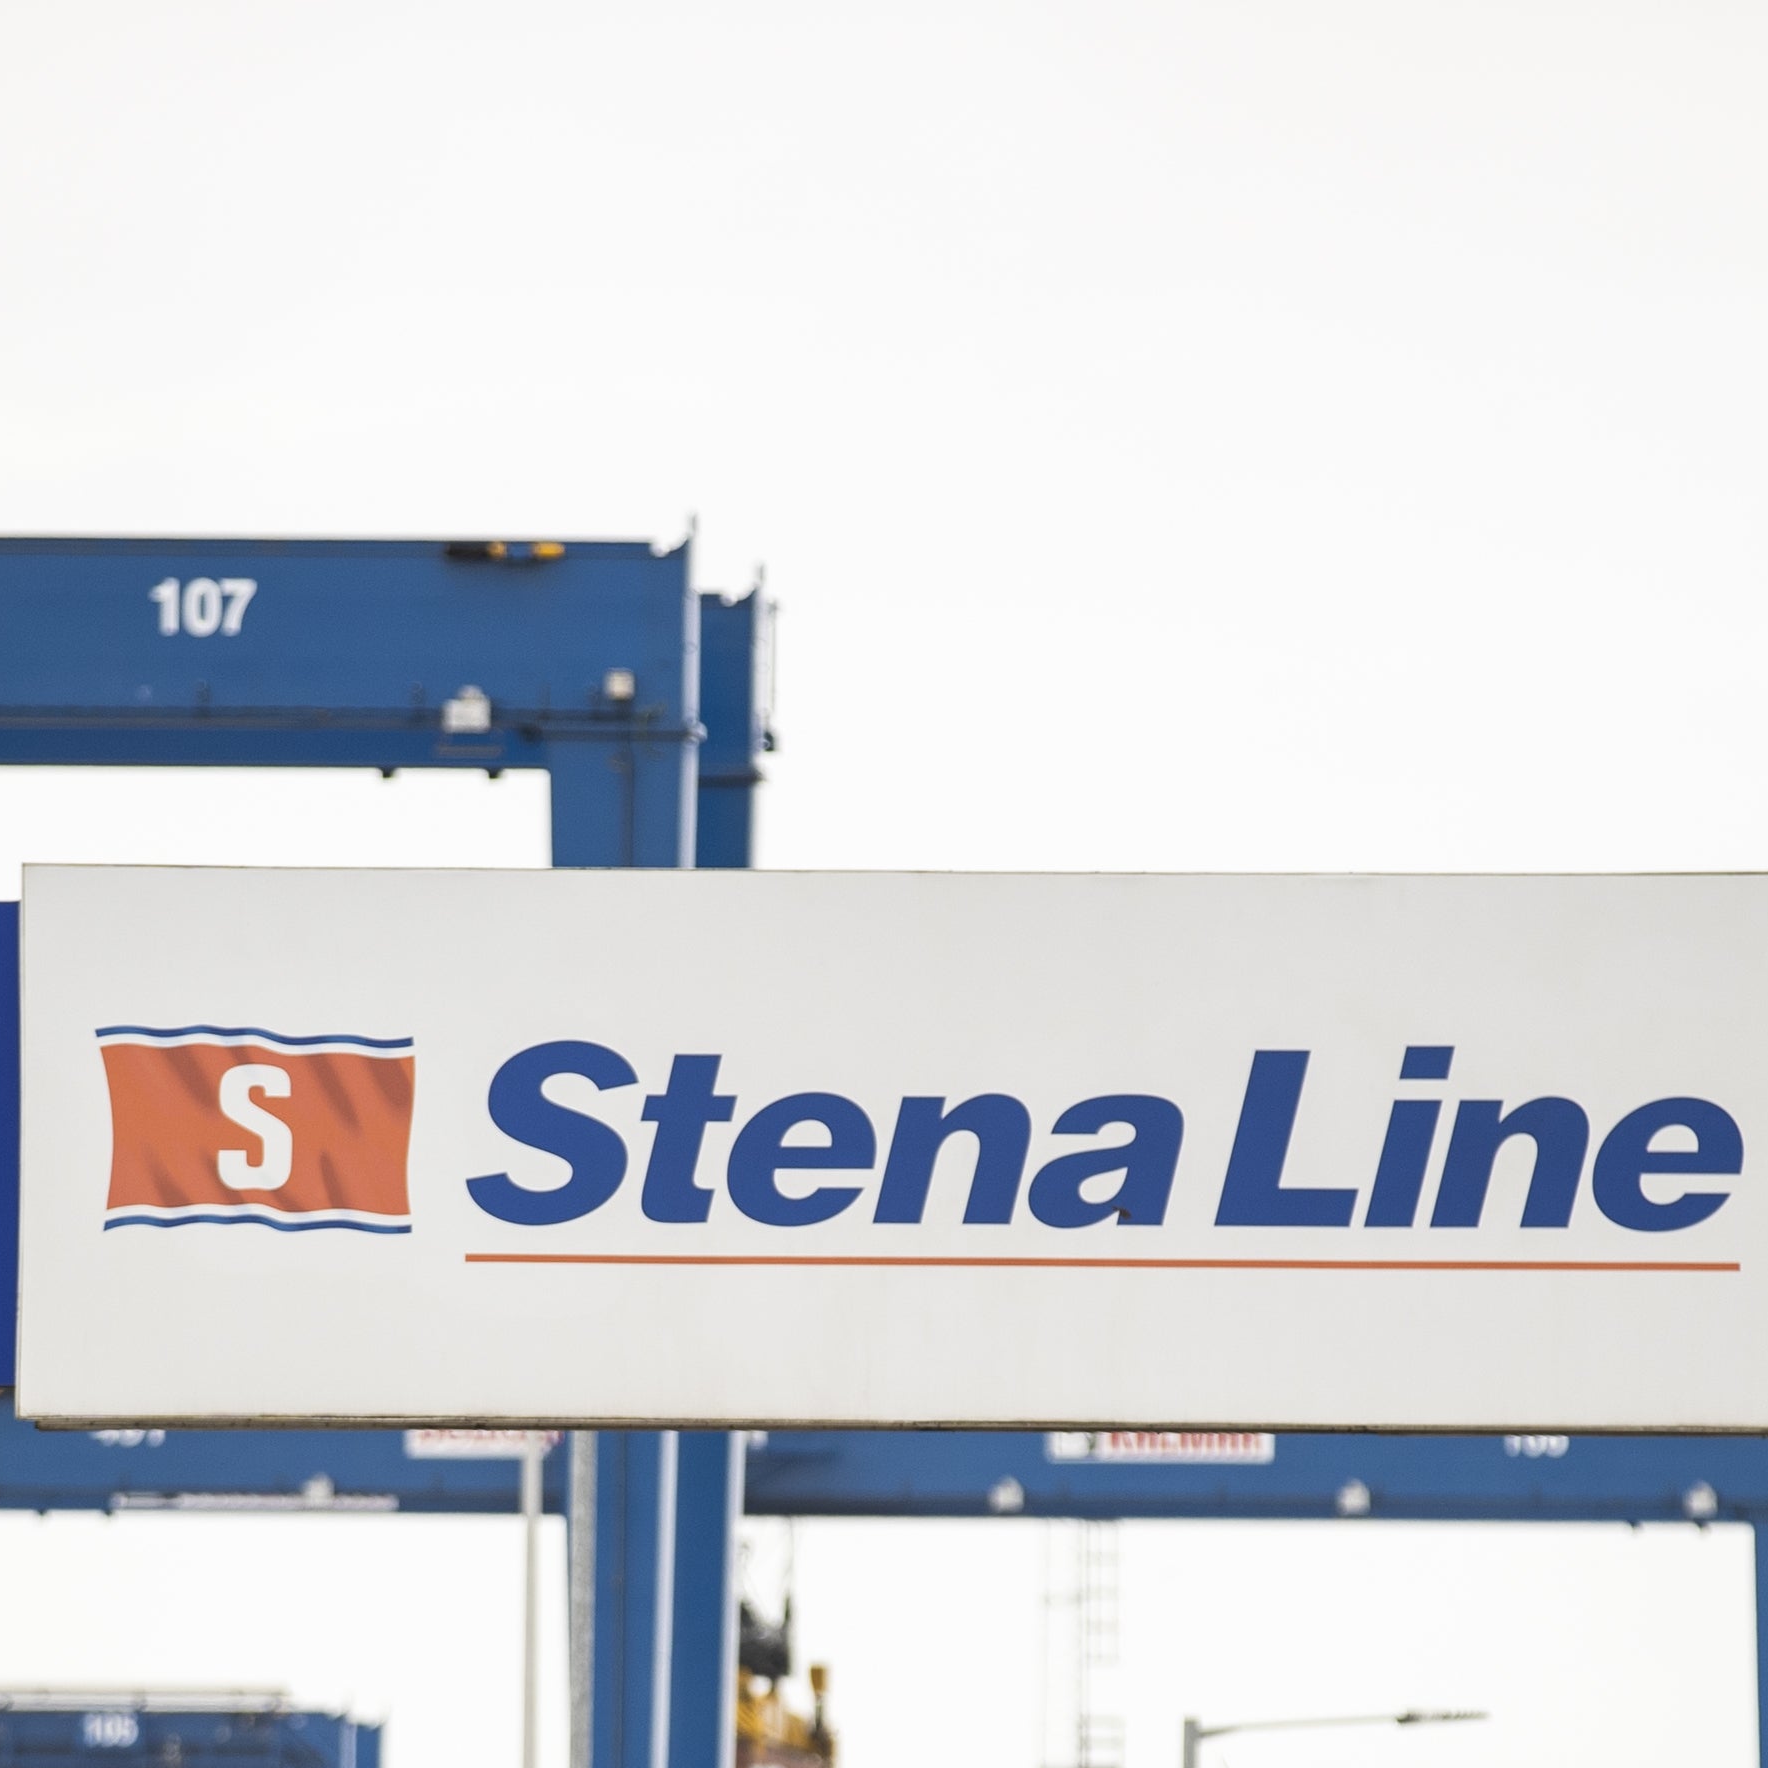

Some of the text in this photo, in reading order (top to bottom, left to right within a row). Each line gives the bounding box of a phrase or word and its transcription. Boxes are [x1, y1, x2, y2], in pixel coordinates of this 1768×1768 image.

[148, 577, 257, 637] 107
[465, 1039, 1744, 1233] Stena Line
